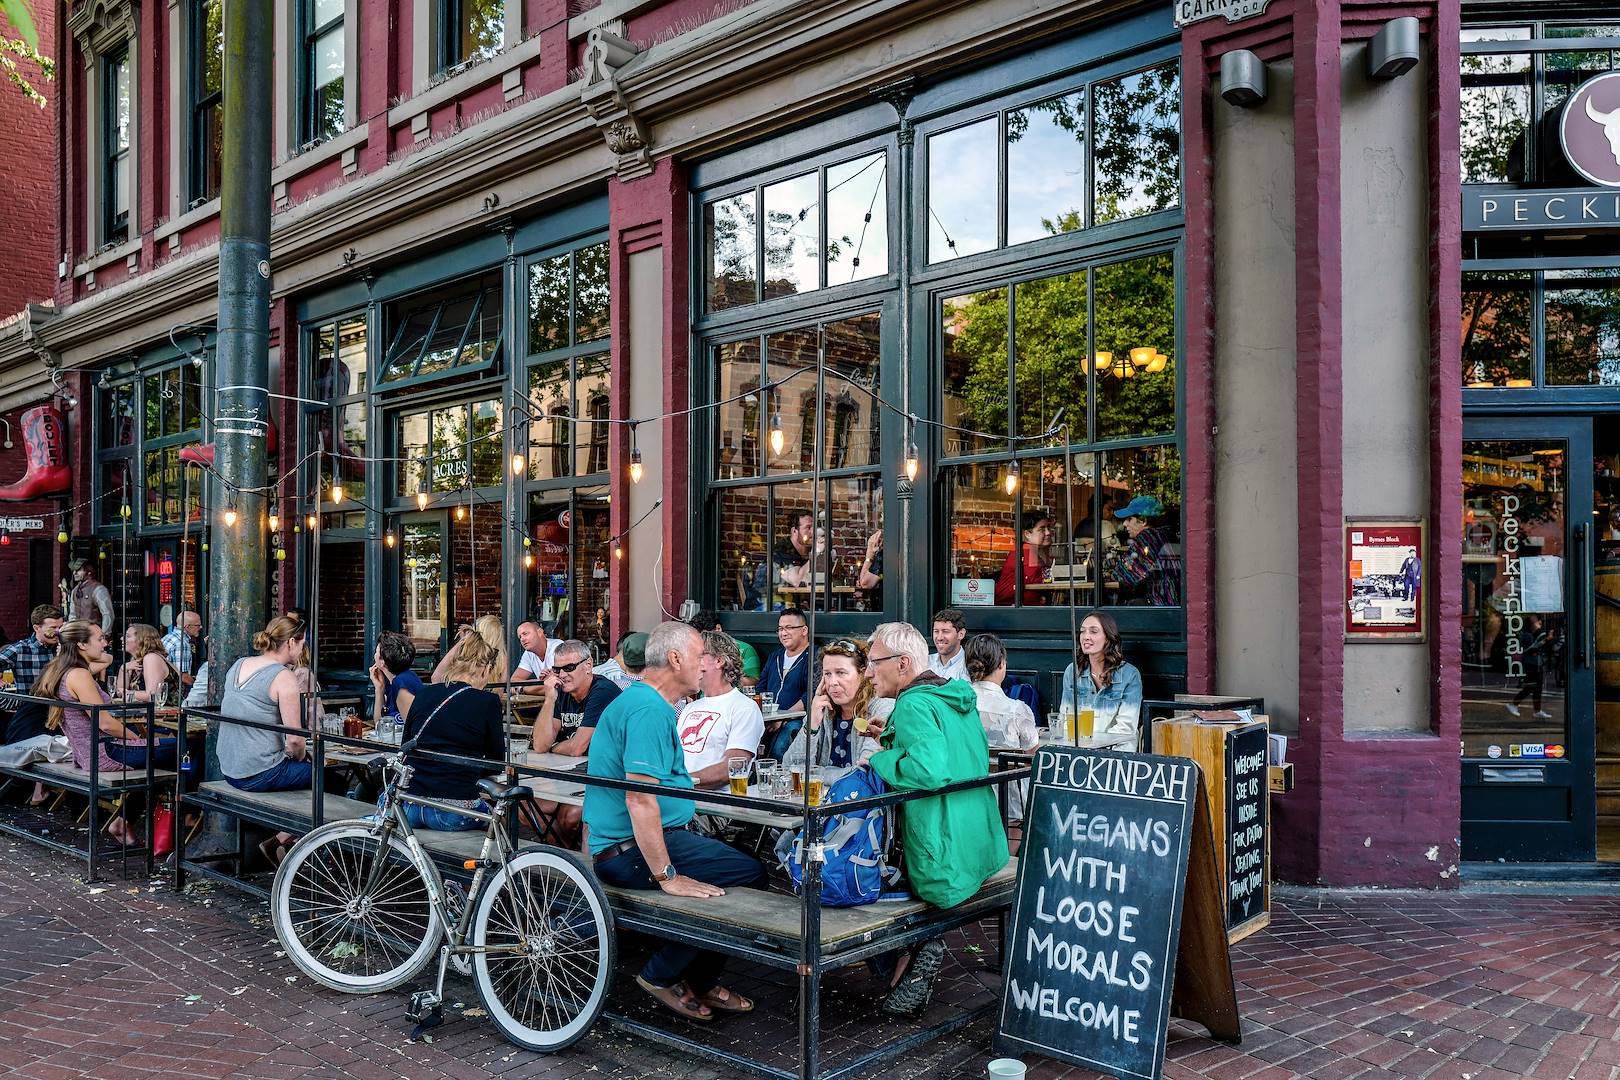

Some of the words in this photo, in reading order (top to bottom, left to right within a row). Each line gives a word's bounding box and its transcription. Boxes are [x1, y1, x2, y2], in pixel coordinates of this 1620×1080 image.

[1233, 2, 1258, 17] 200
[1482, 196, 1620, 221] PECKI
[436, 460, 467, 477] ACRES
[160, 562, 173, 575] OPEN
[1501, 494, 1526, 677] peckinpah
[1234, 750, 1265, 775] WELCOME!
[1034, 751, 1191, 800] PECKINPAH
[1236, 782, 1248, 800] SEE
[1249, 778, 1259, 796] US
[1239, 802, 1258, 823] INSIDE
[1051, 802, 1171, 857] VEGANS
[1246, 824, 1262, 847] PATIO
[1043, 847, 1127, 894] WITH
[1230, 876, 1250, 900] THANK
[1036, 886, 1140, 943] LOOSE
[1026, 927, 1154, 992] MORALS
[1011, 978, 1141, 1044] WELCOME
